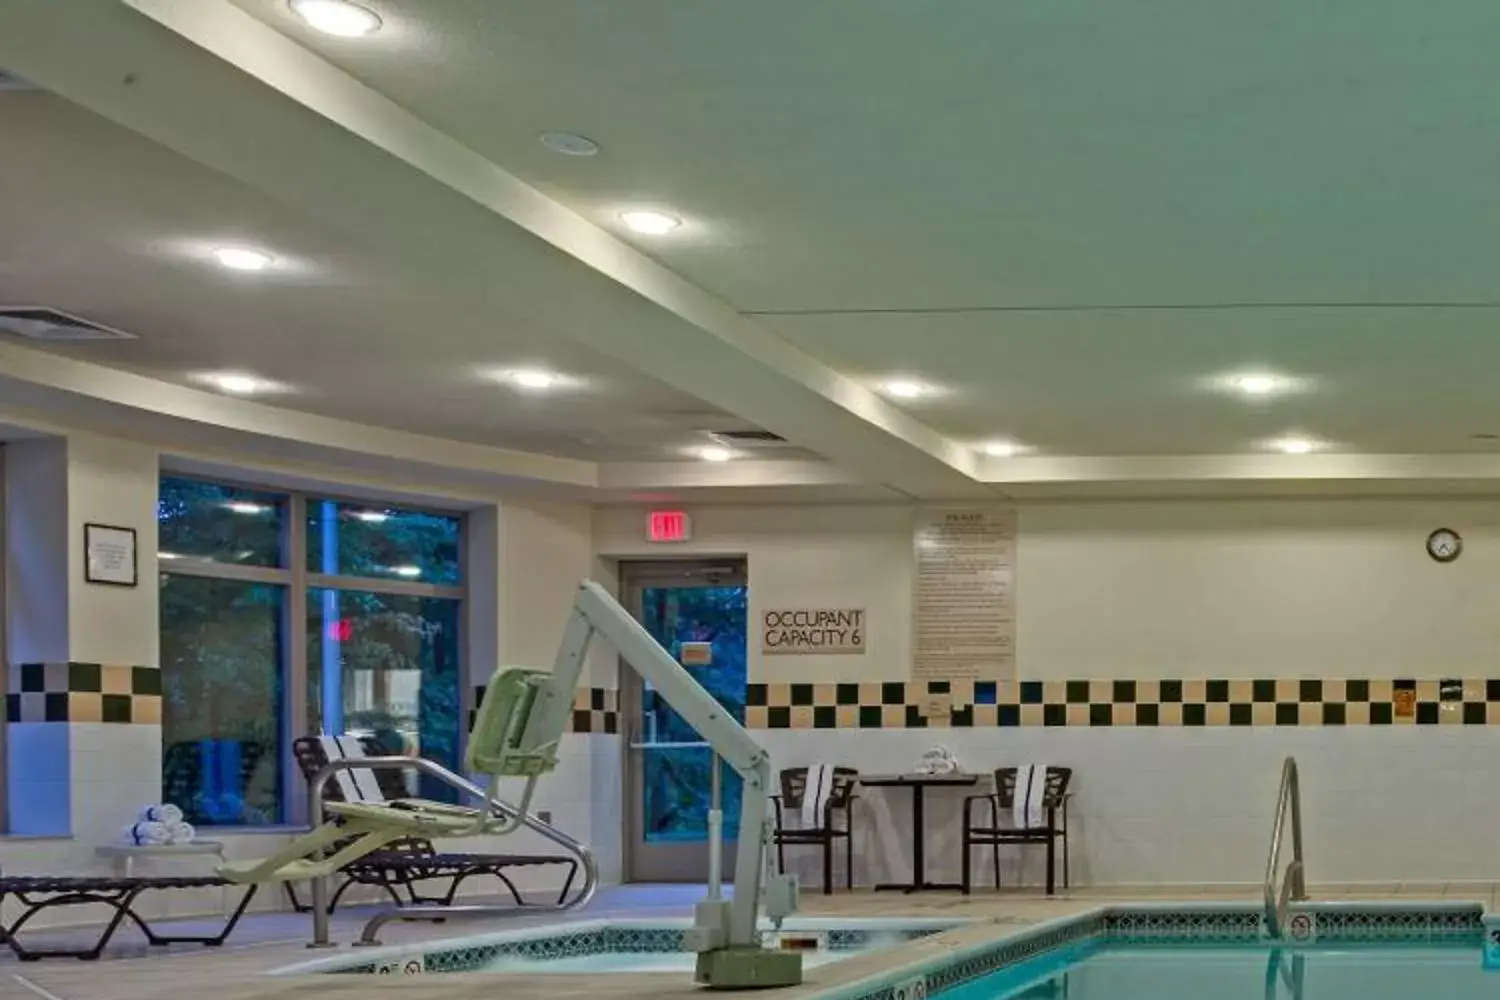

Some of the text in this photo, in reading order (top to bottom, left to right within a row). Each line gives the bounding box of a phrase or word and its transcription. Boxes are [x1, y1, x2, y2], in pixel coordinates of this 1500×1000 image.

[765, 610, 862, 627] OCCUPANT
[765, 629, 861, 647] CAPACITY 6
